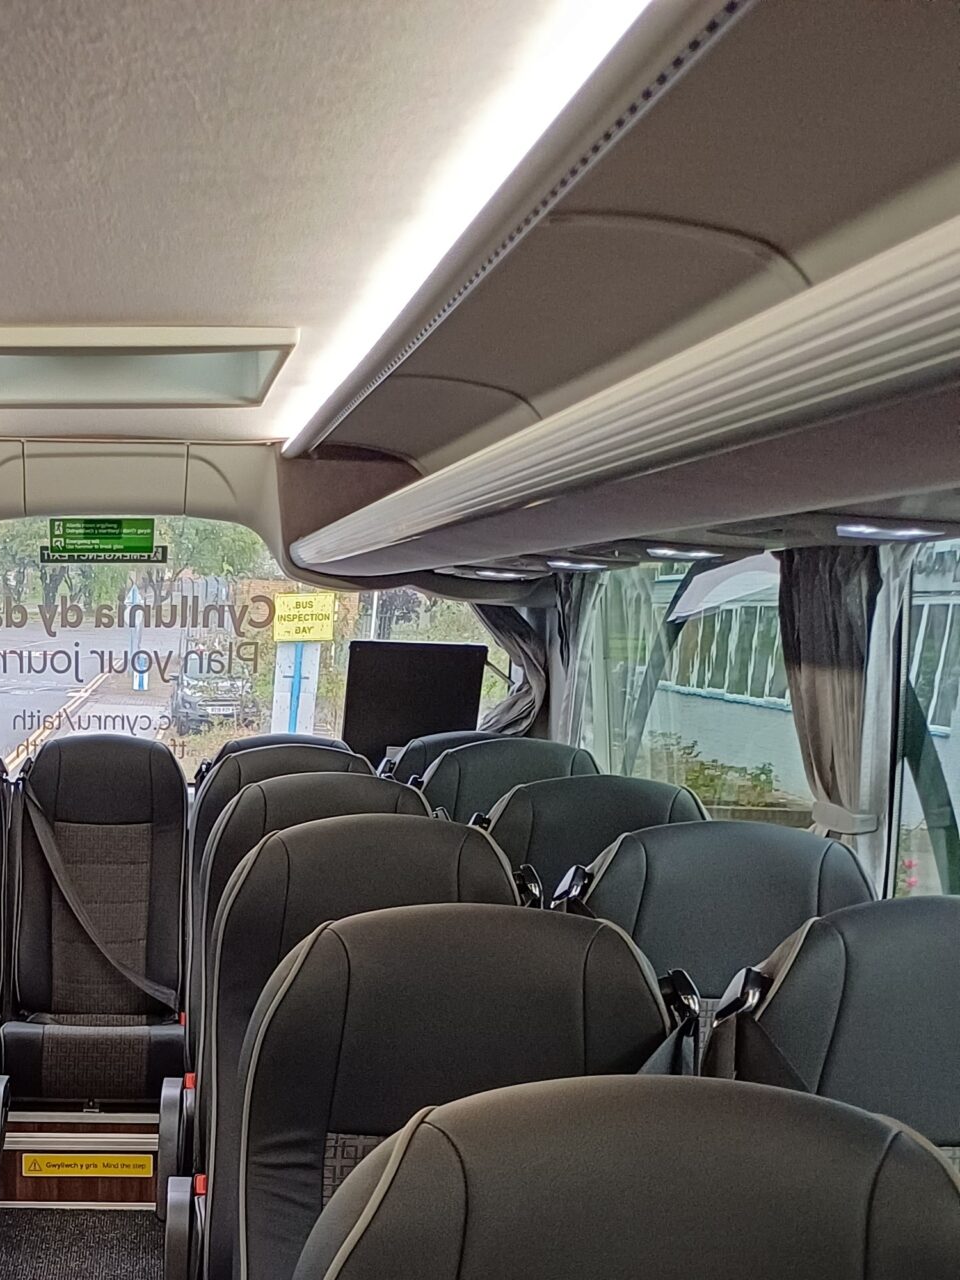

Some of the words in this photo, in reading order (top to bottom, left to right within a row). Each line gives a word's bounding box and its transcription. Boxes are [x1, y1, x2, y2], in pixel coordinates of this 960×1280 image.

[295, 600, 314, 610] BUS
[277, 613, 330, 622] INSPECTION
[85, 1162, 98, 1170] gris
[120, 1162, 131, 1170] the
[132, 1163, 147, 1171] step
